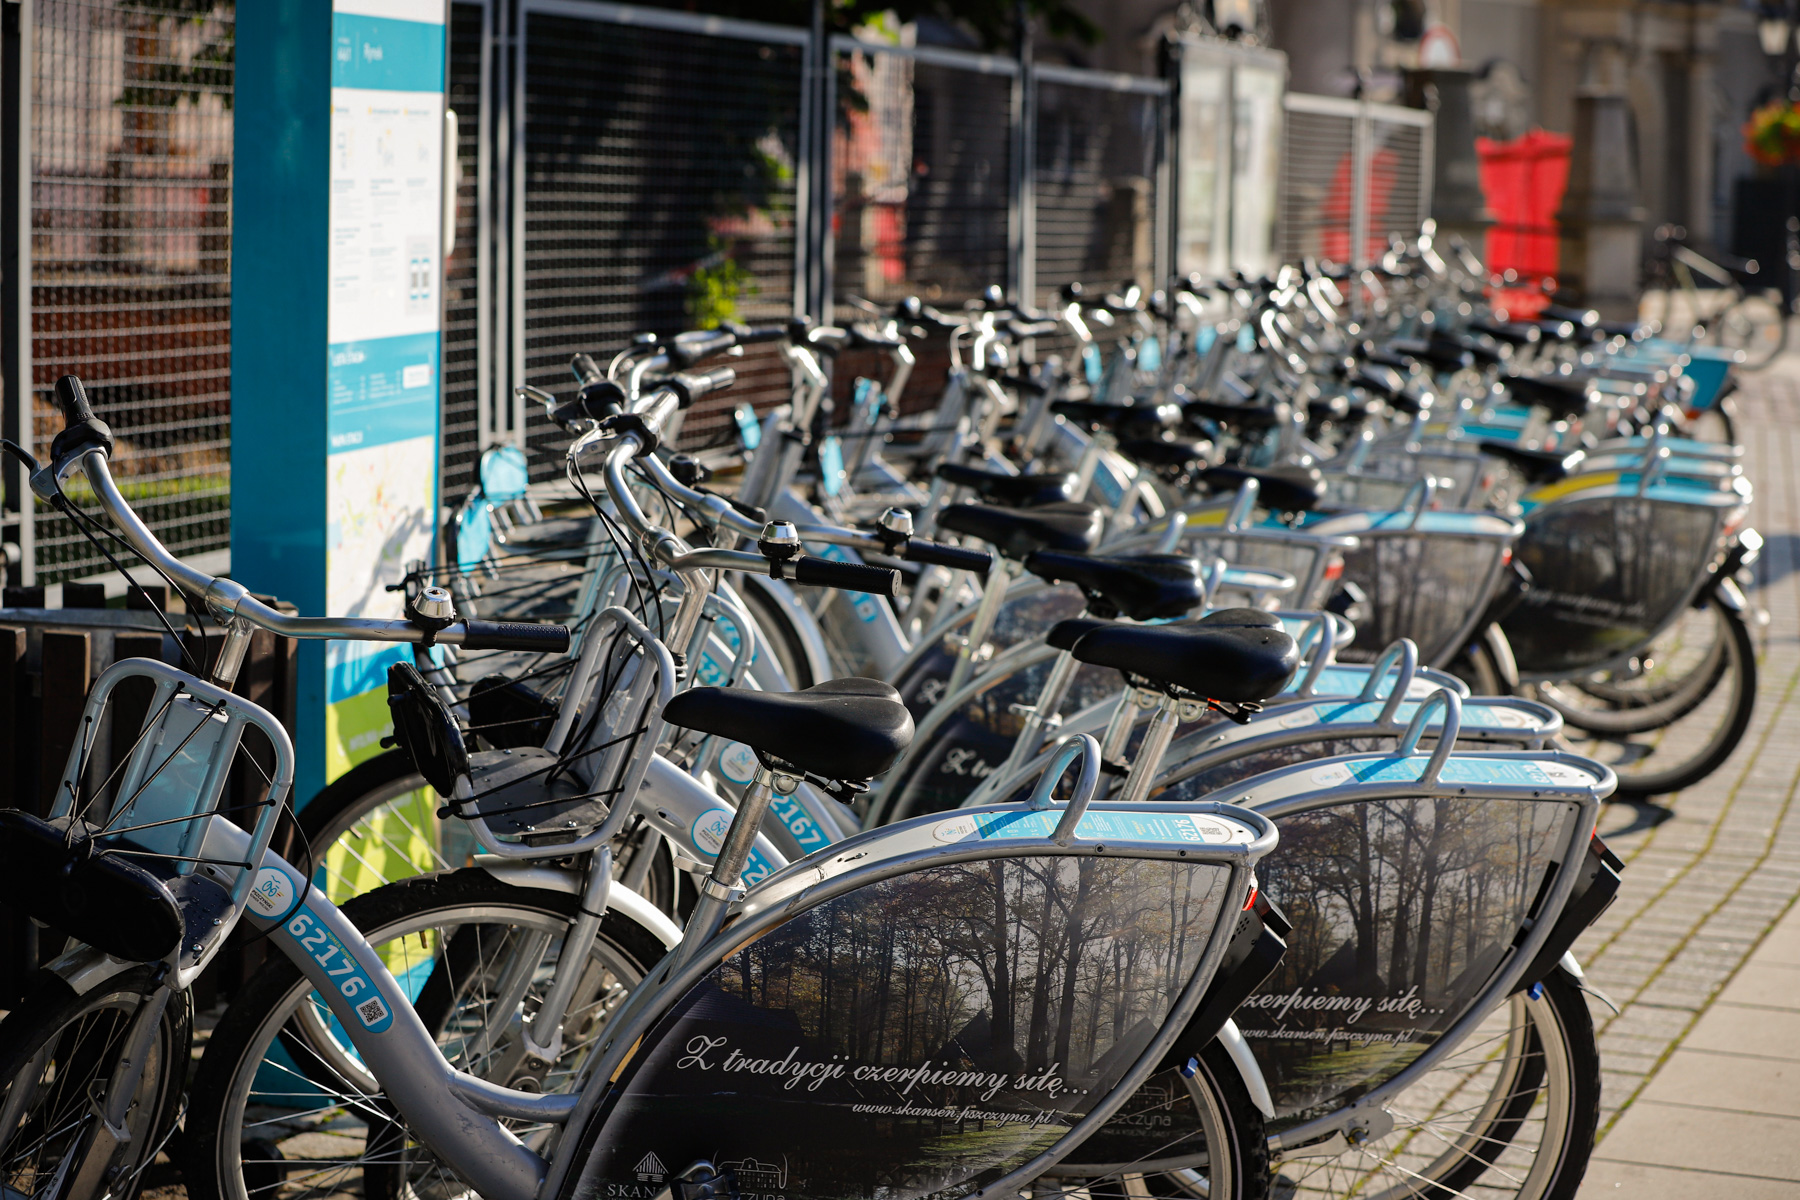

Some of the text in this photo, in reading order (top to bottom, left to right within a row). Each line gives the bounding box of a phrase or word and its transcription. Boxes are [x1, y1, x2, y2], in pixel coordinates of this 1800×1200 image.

[288, 914, 366, 997] 62176
[677, 1035, 727, 1070] Z
[722, 1046, 850, 1091] tradycji
[852, 1061, 1008, 1100] czerpiemy
[852, 1100, 1056, 1129] www.skansen.pszczyna.pl
[606, 1183, 663, 1198] SKAN
